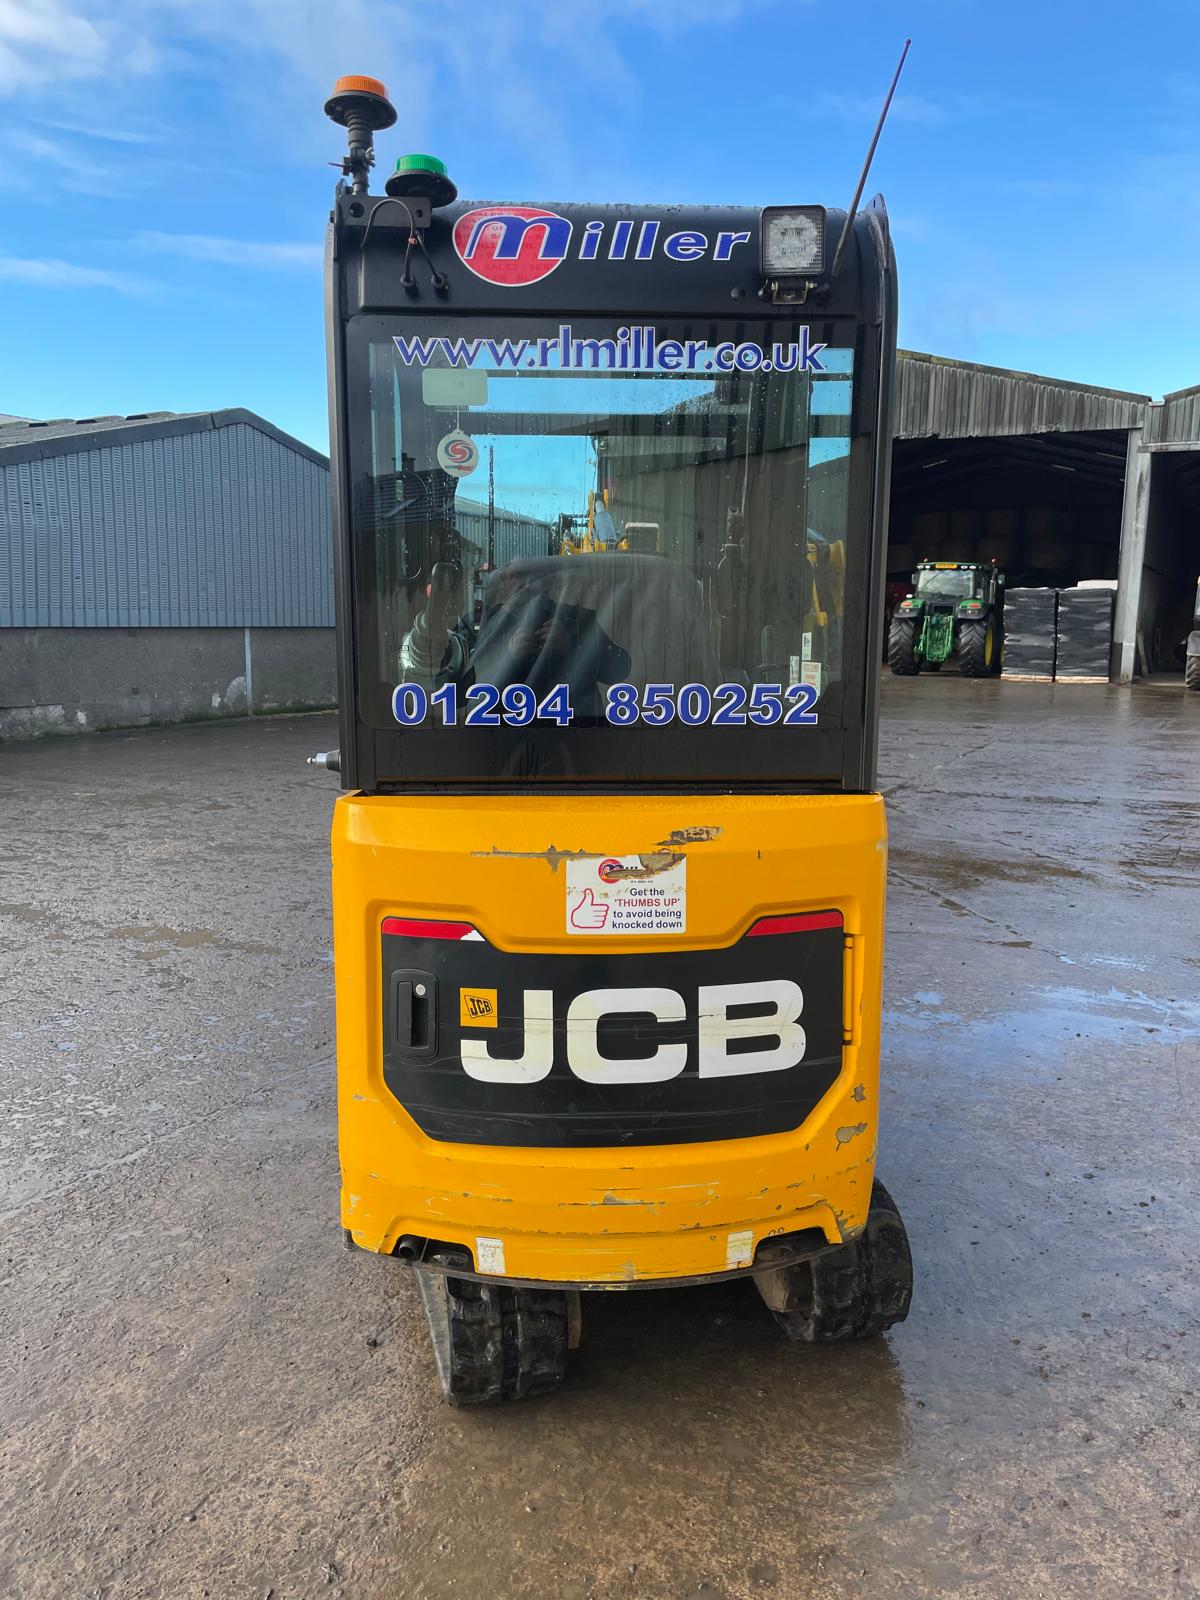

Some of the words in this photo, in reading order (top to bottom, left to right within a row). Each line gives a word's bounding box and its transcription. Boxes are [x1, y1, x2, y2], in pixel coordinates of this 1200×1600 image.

[392, 325, 827, 373] www.rlmiller.co.uk
[392, 682, 574, 726] 01294
[605, 682, 819, 726] 850252
[630, 888, 648, 896] Get
[650, 887, 665, 896] the
[626, 910, 652, 918] avoid
[654, 910, 682, 919] being
[612, 921, 654, 929] knocked
[469, 997, 491, 1016] JCB
[460, 980, 806, 1084] JCB
